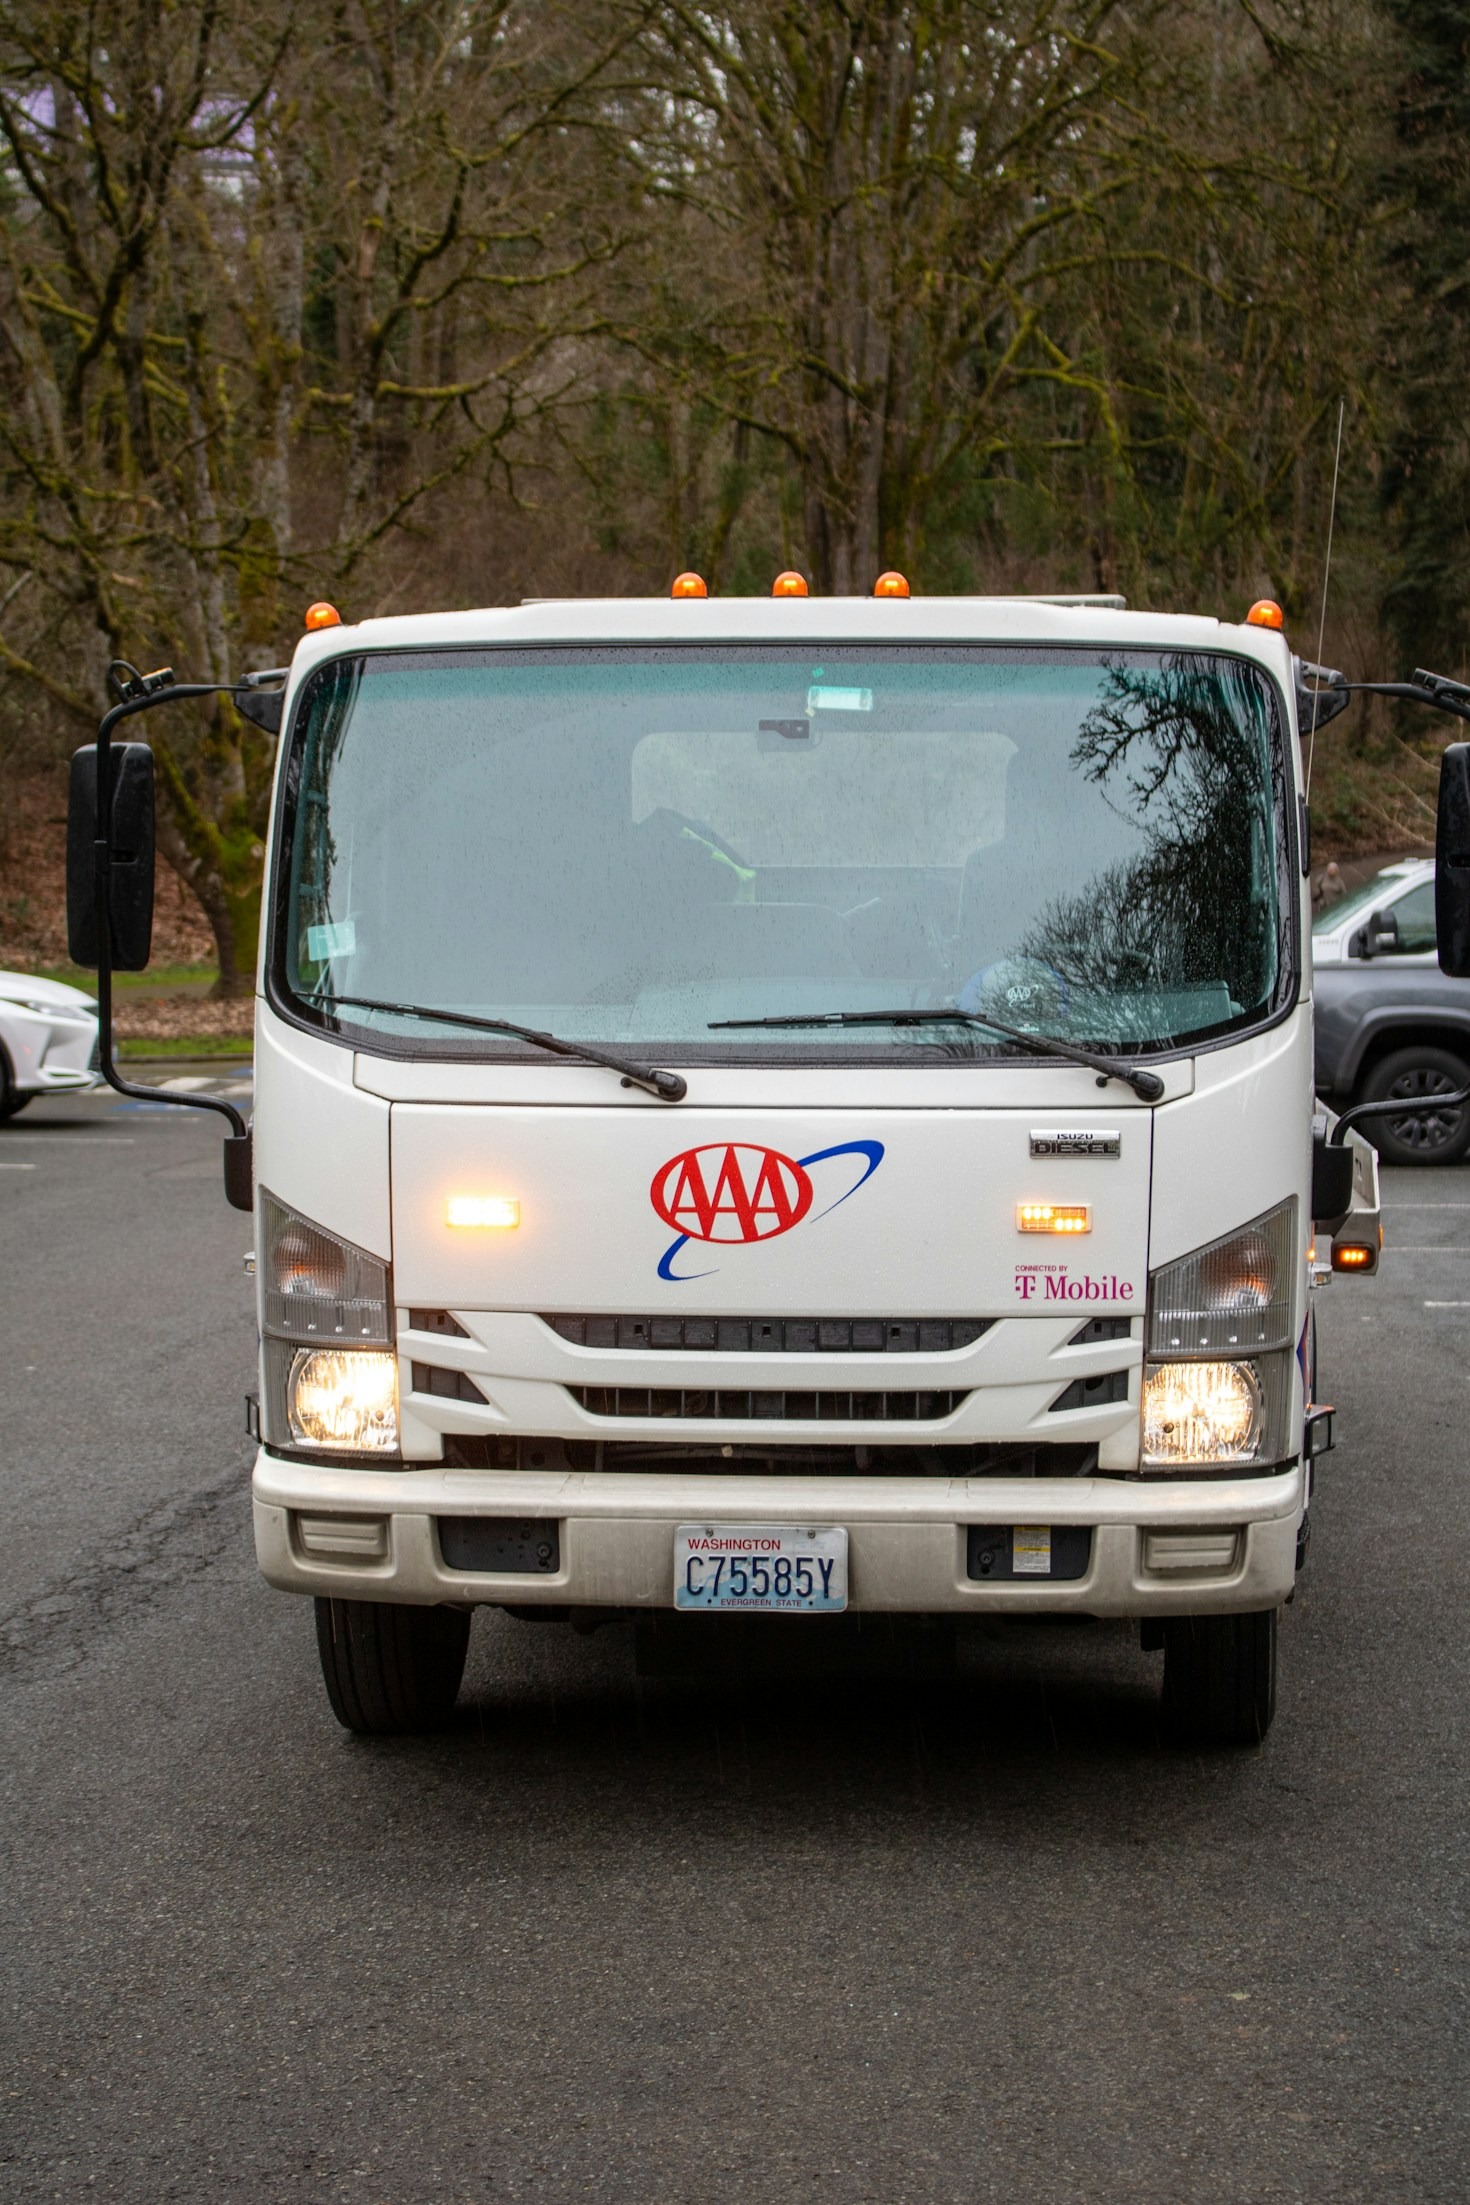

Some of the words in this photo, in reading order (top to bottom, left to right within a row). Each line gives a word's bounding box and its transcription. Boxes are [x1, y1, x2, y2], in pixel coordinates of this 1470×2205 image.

[1034, 1142, 1117, 1154] DIESEL
[662, 1143, 802, 1243] AAA
[1043, 1275, 1134, 1300] Mobile
[688, 1539, 781, 1550] WASHINGTON
[686, 1556, 834, 1599] C75585Y
[721, 1598, 772, 1607] EVERGREEN
[776, 1599, 802, 1607] STATE
